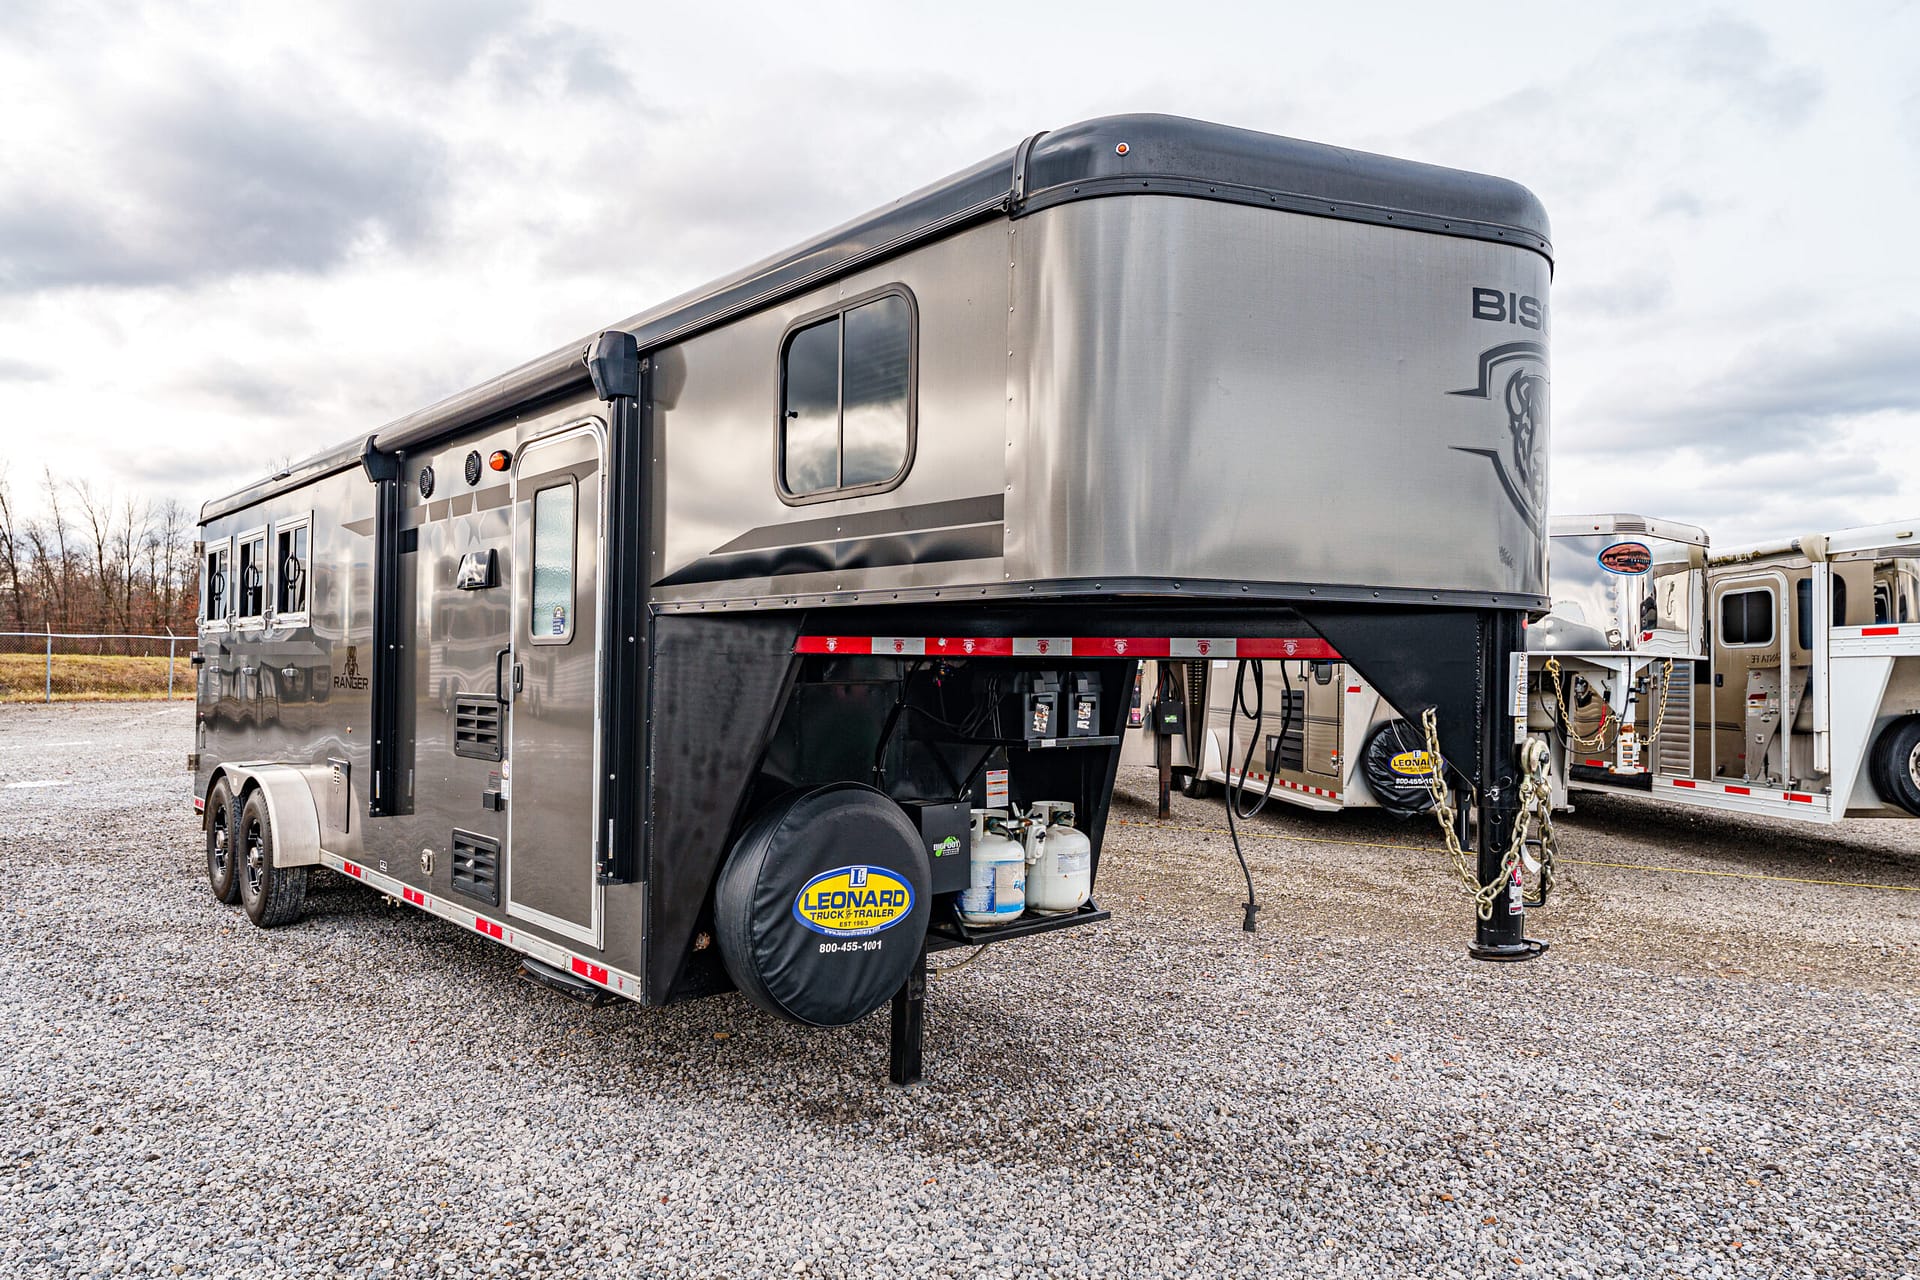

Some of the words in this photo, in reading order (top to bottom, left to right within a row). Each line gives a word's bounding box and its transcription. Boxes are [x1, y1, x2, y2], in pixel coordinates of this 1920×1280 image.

[333, 676, 368, 690] RANGER
[1393, 759, 1439, 767] LEONA
[804, 889, 905, 910] LEONARD
[810, 909, 843, 920] TRUCK
[854, 909, 894, 919] TRAILER
[819, 940, 882, 953] 800-455-1001
